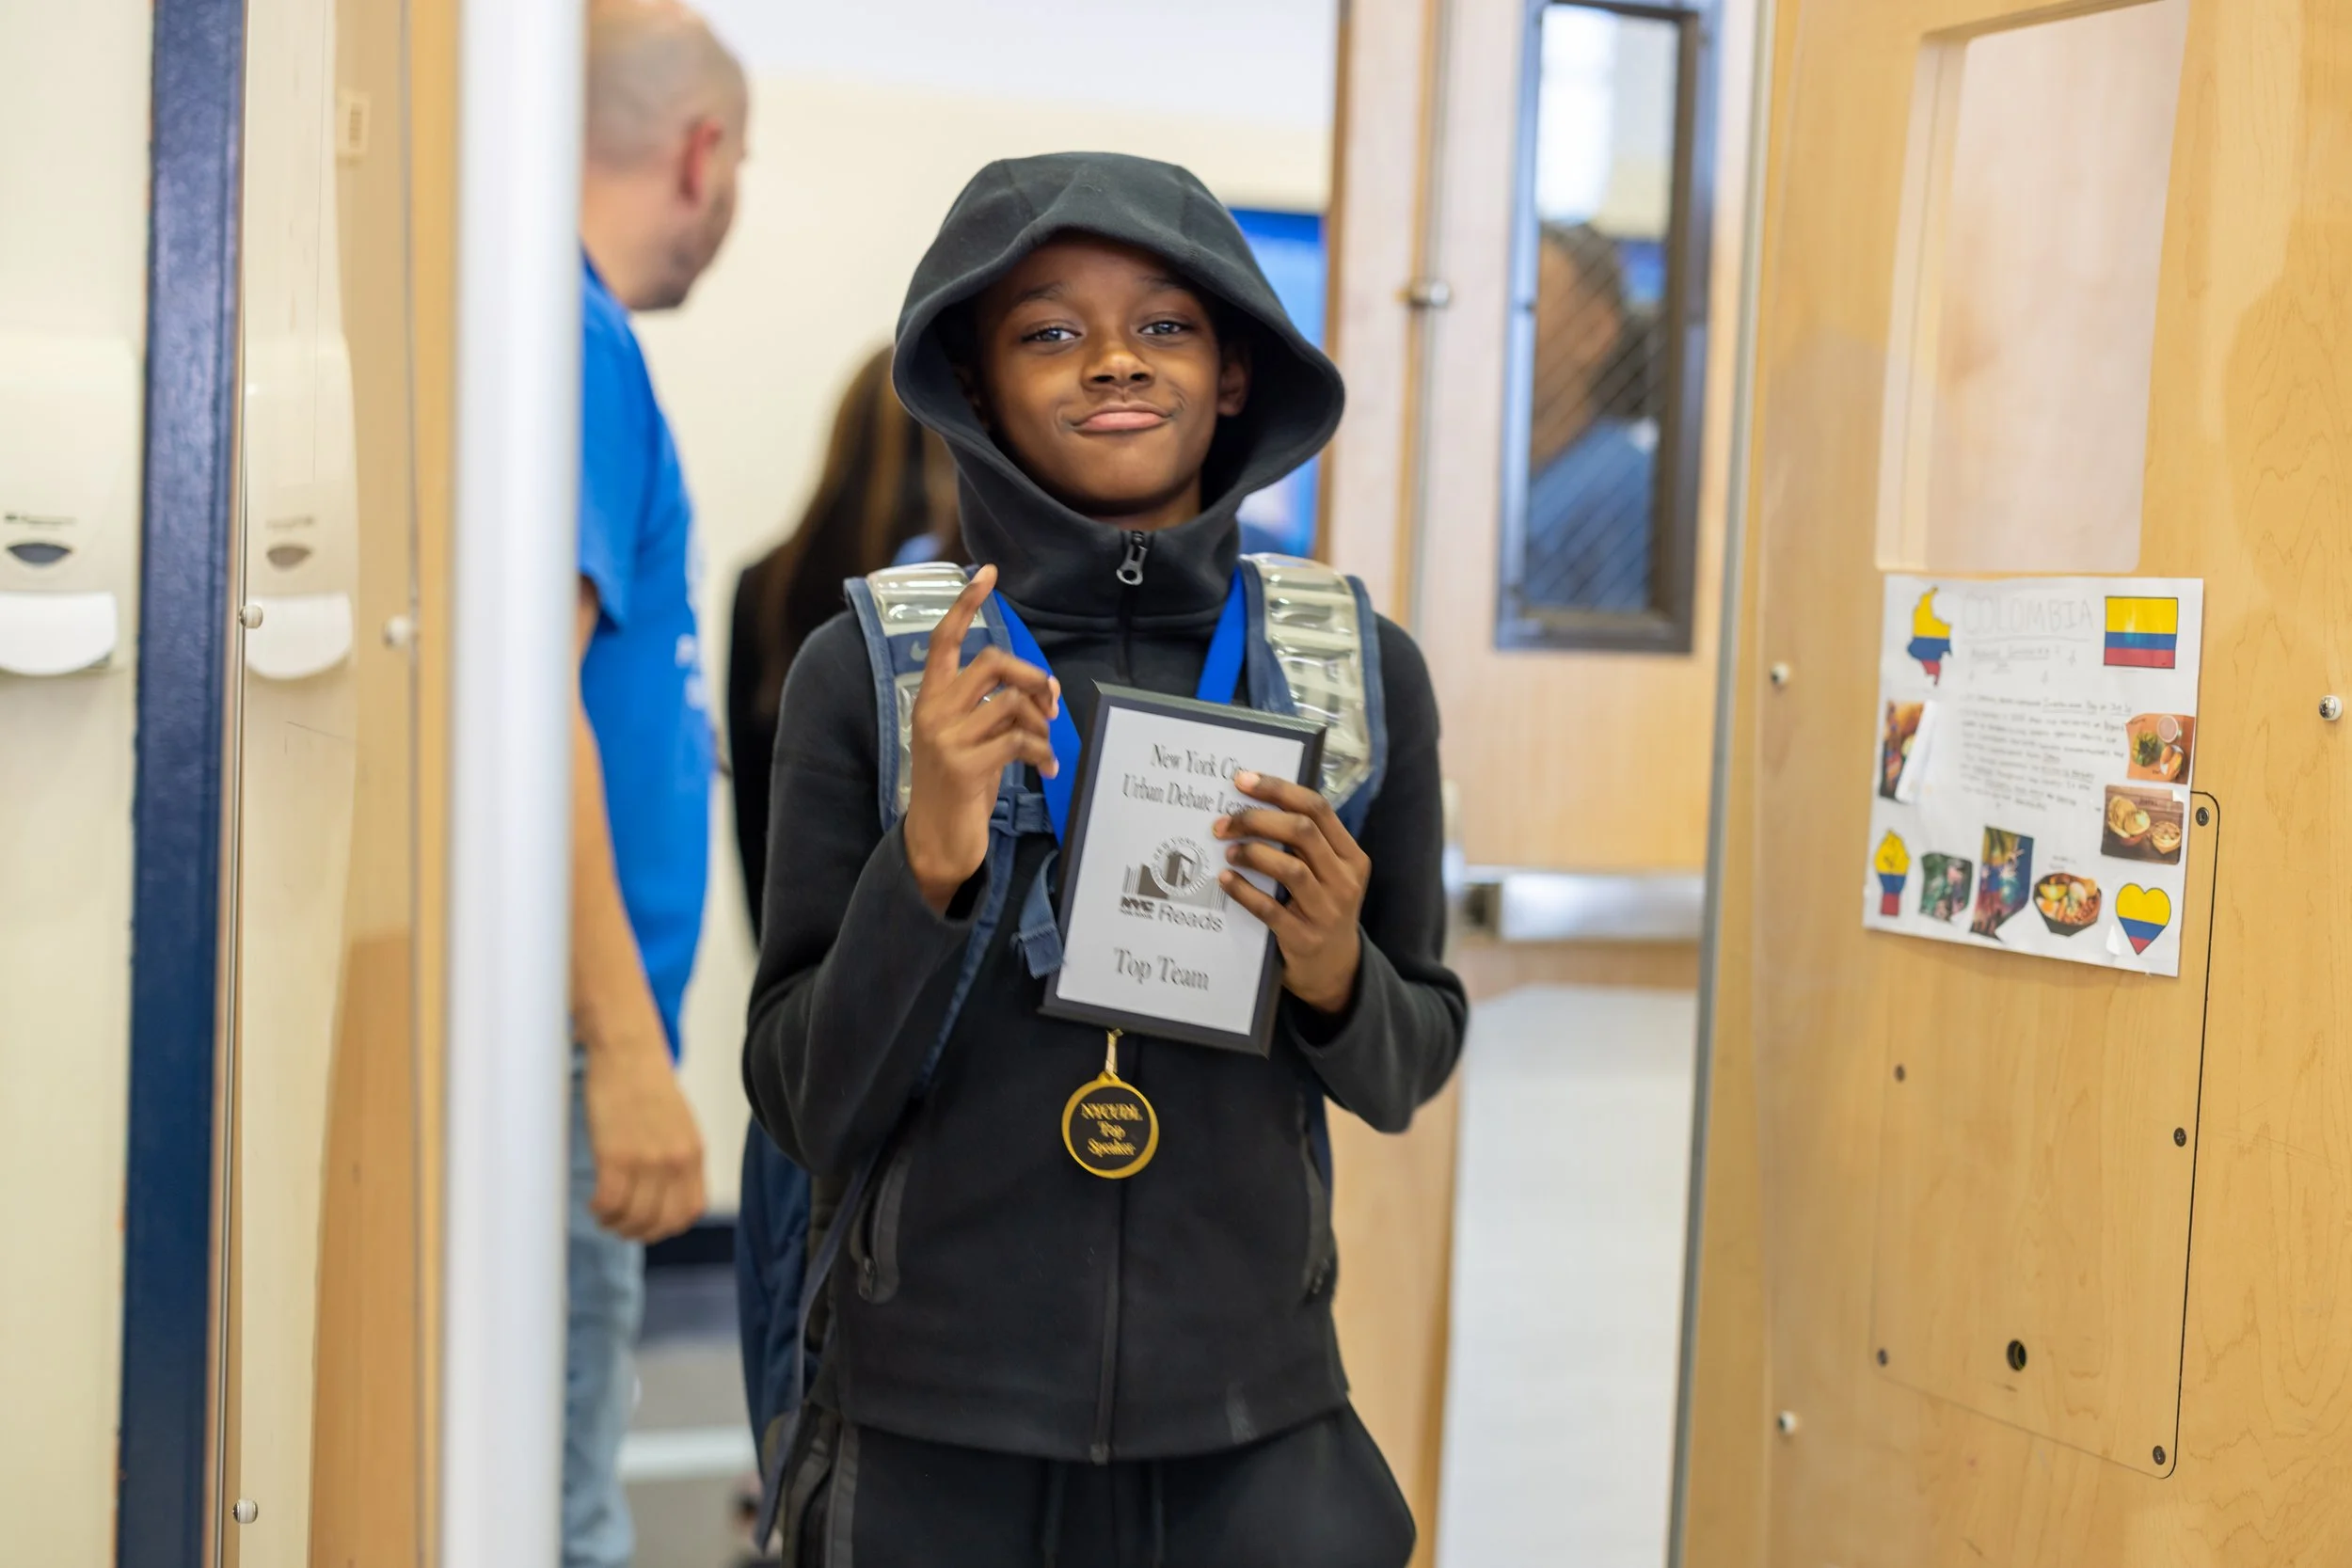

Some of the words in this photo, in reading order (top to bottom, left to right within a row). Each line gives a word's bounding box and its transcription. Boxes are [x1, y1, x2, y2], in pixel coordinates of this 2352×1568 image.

[1963, 593, 2094, 635] COLOMBIA
[1150, 743, 1182, 769] New
[1184, 750, 1217, 778] York
[1122, 773, 1165, 803] Urban
[1168, 782, 1215, 813] Debate
[1158, 902, 1223, 932] Reads
[1114, 947, 1152, 985] Top
[1157, 955, 1210, 990] Team
[1088, 1137, 1136, 1158] Speaker
[1097, 1120, 1126, 1140] Top
